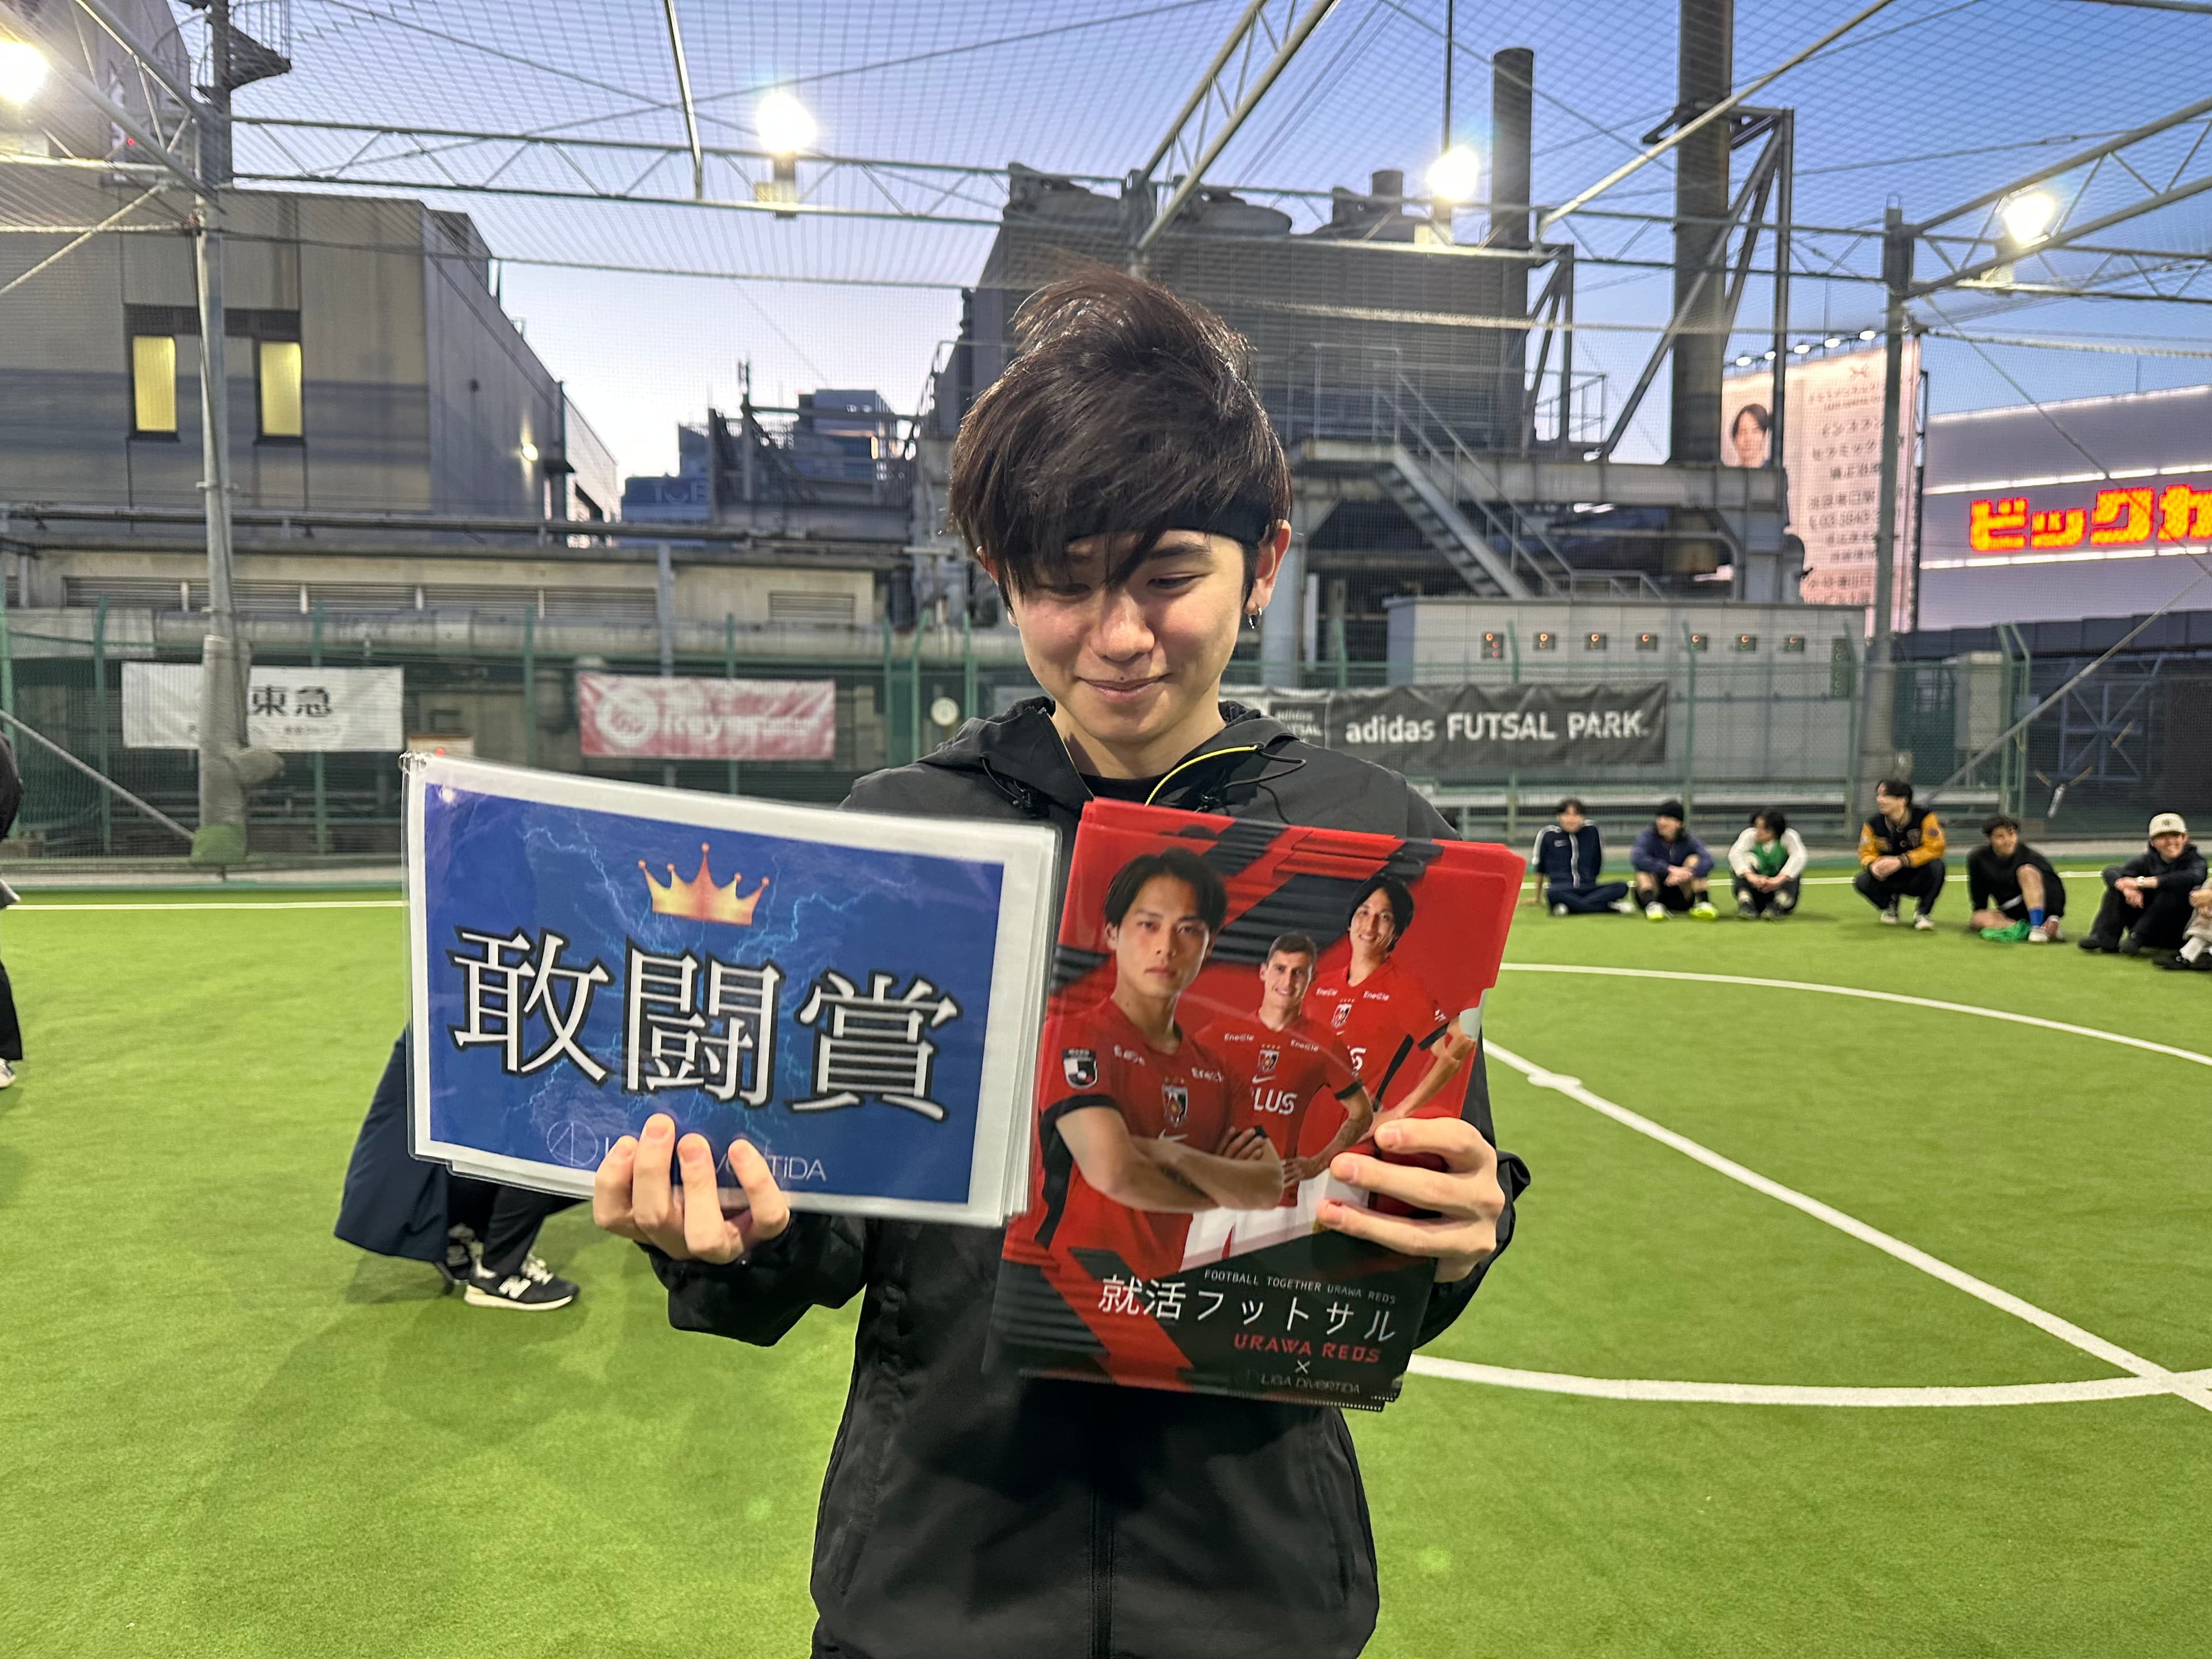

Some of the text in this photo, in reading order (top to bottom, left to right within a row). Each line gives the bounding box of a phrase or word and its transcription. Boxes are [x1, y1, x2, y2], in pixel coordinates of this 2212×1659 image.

[1969, 484, 2212, 552] ビックカ
[251, 684, 333, 718] 東急
[1345, 714, 1435, 743] adidas
[1446, 711, 1556, 741] FUTSAL
[446, 926, 962, 1121] 敢闘賞
[1204, 1268, 1396, 1305] FOOTBALL TOGETHER URAWA REDS
[1098, 1273, 1396, 1343] 就活フットサル
[1233, 1332, 1380, 1363] URAWA REDS
